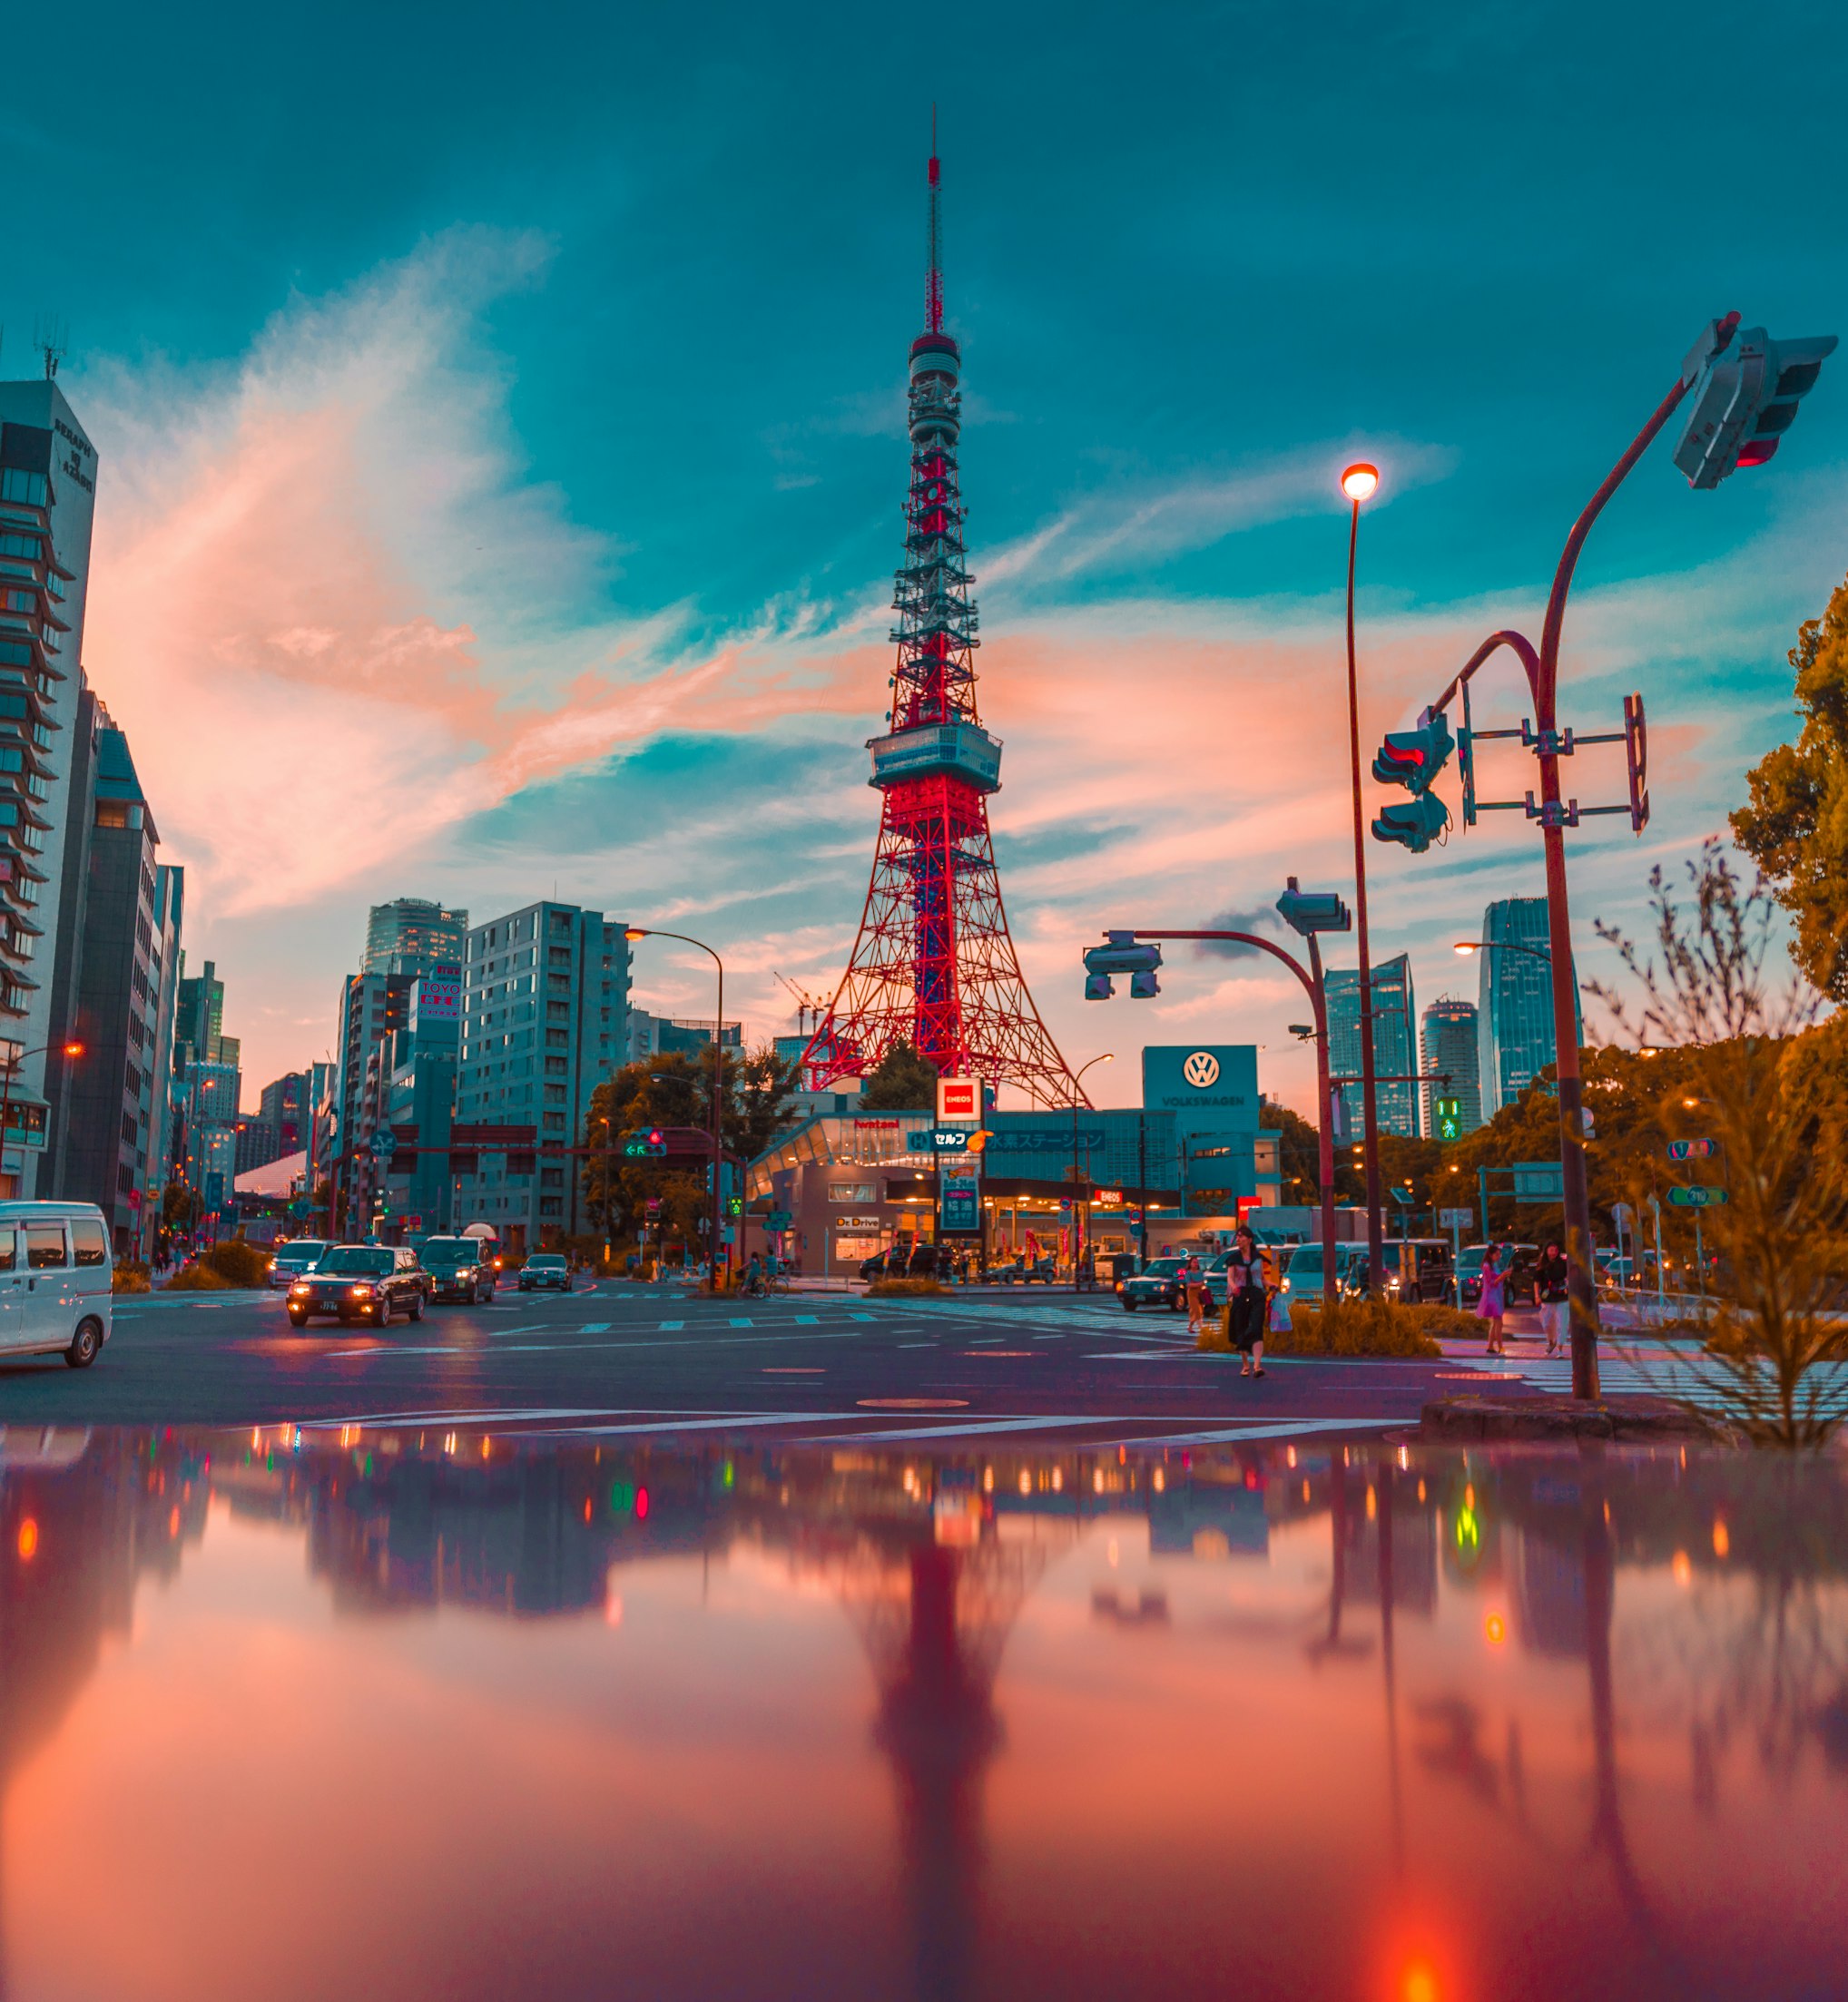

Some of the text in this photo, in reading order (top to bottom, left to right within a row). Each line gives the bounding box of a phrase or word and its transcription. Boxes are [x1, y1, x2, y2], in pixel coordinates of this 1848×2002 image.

[421, 982, 460, 995] TOYO
[946, 1095, 971, 1104] ENEOS
[1162, 1095, 1245, 1106] VOLKSWAGEN
[854, 1118, 899, 1129] Iwatani
[935, 1133, 966, 1145] セルフ
[988, 1134, 1102, 1148] 水素ステーション
[1100, 1191, 1120, 1203] ENEOS
[851, 1218, 879, 1227] Drive
